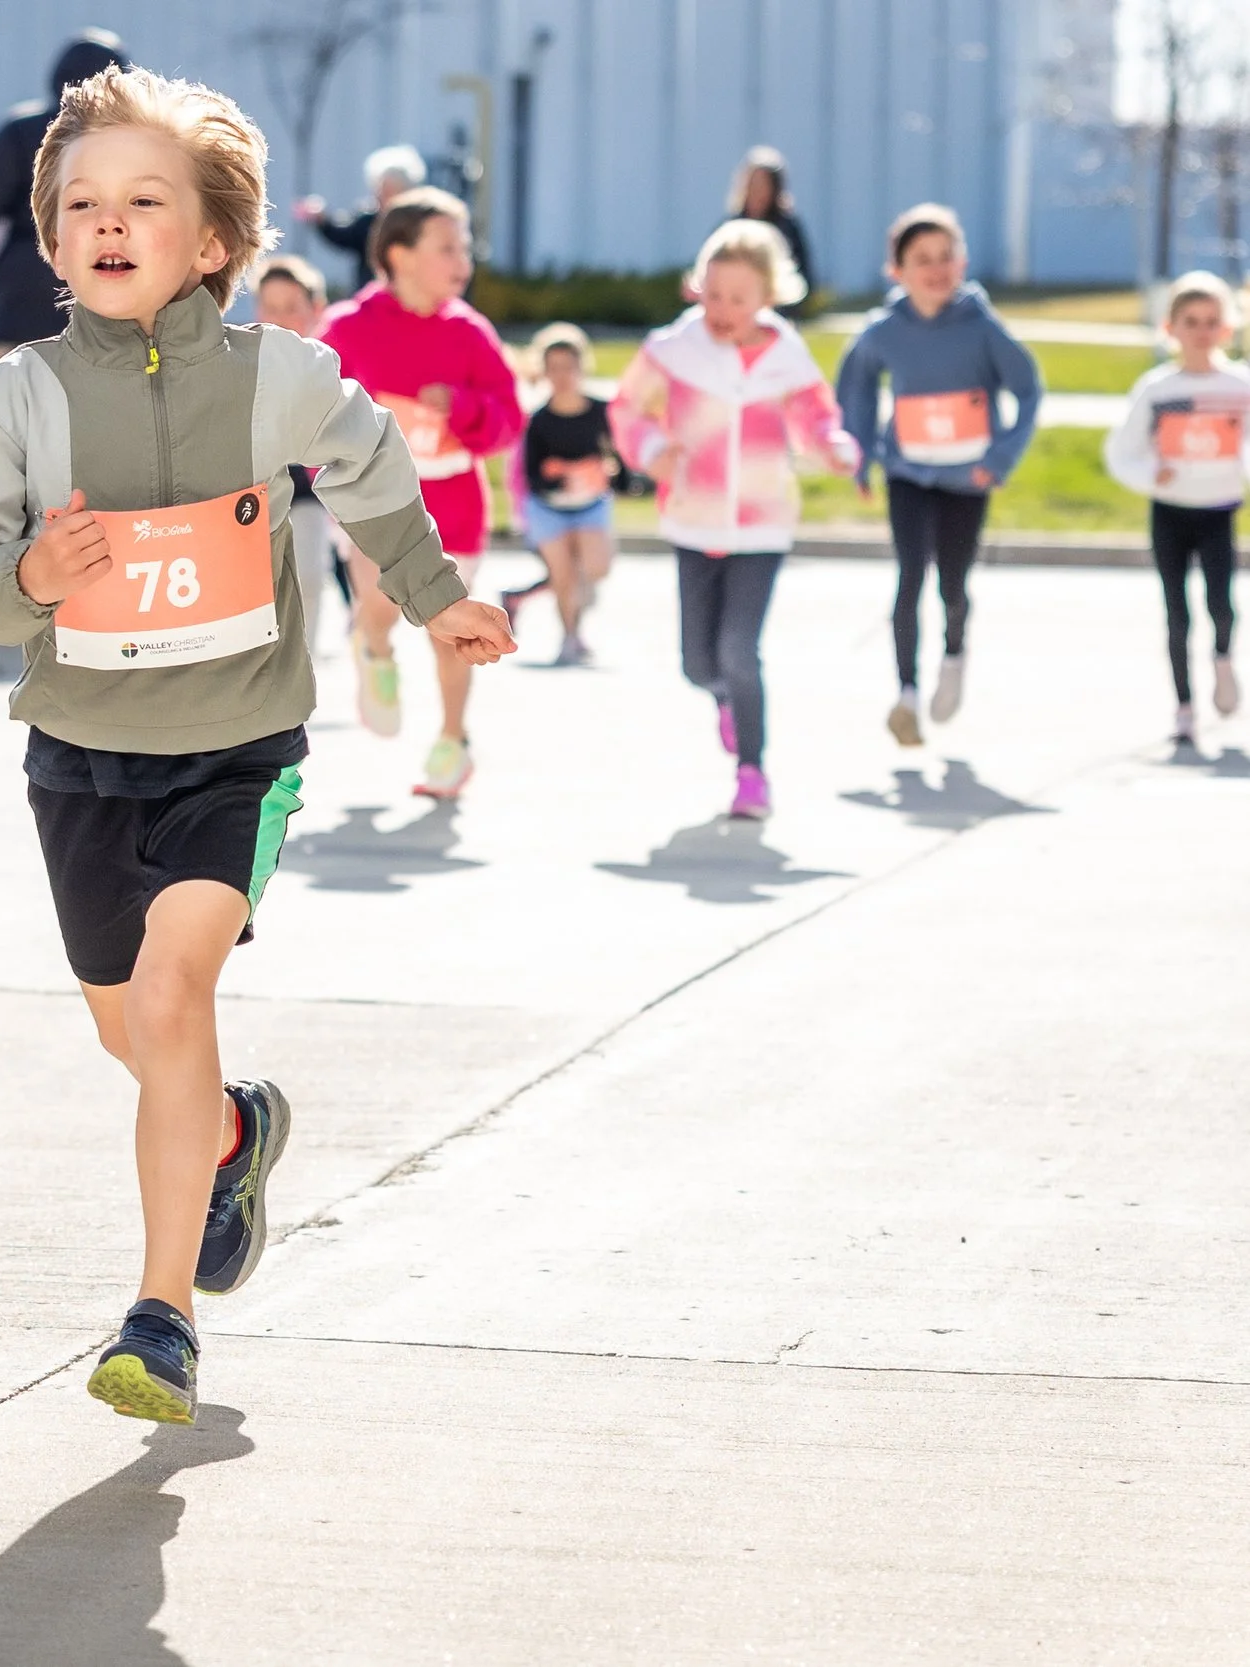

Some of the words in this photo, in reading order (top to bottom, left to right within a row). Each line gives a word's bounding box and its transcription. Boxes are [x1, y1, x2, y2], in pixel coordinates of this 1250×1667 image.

[126, 557, 201, 613] 78
[139, 641, 173, 650] VALLEY
[174, 635, 216, 647] CHRISTIAN
